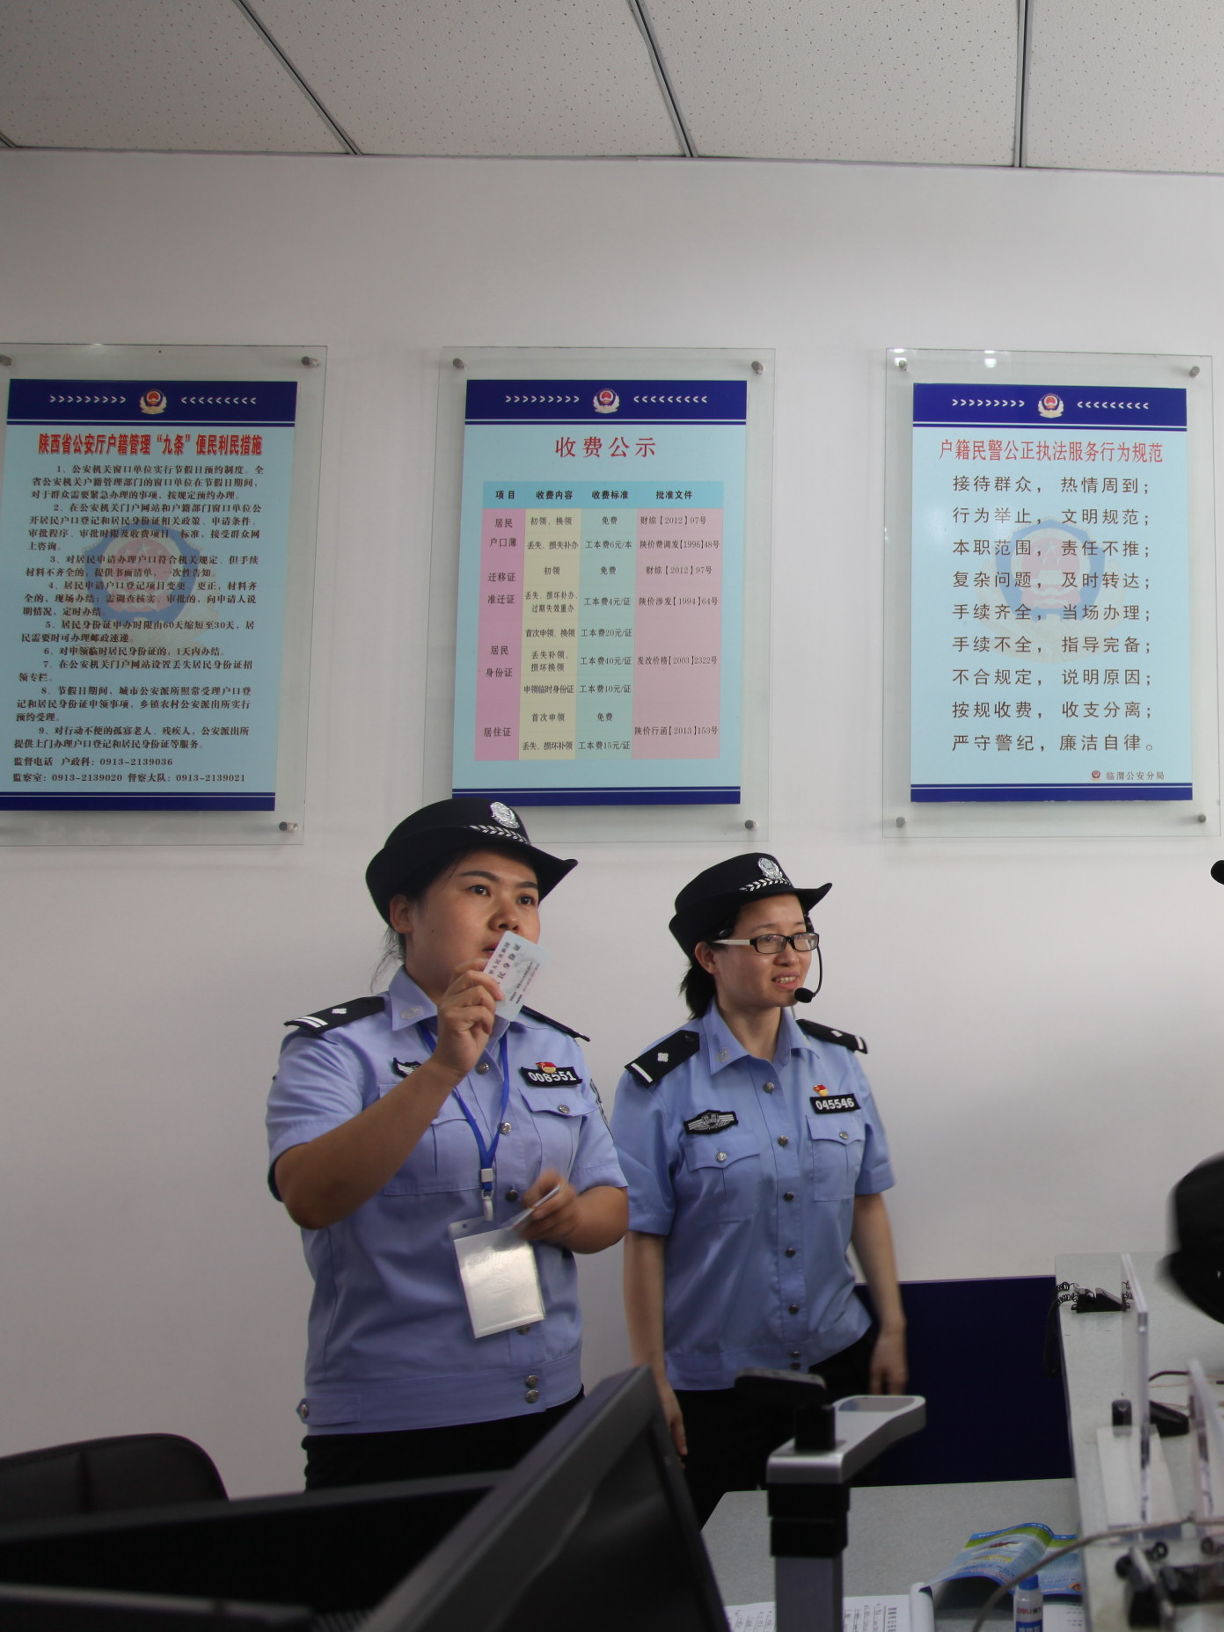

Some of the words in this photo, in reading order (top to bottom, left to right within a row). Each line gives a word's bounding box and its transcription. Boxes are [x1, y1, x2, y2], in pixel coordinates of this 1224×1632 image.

[555, 437, 656, 458] 收费公示
[940, 439, 1163, 463] 户籍民警公正执法服务行为规范
[536, 490, 574, 499] 收费内容
[592, 490, 629, 499] 收费标准
[656, 490, 693, 499] 批准文件
[495, 518, 513, 528] 居民
[602, 516, 618, 525] 免费
[544, 566, 560, 575] 初领
[600, 566, 616, 575] 免费
[488, 573, 516, 583] 迁移证
[487, 595, 515, 605] 准迁证
[491, 645, 509, 655] 居民
[486, 668, 513, 678] 身份证
[532, 713, 565, 722] 首次申领
[597, 713, 612, 721] 免费
[483, 728, 511, 737] 居住证
[14, 757, 53, 766] 监督电话
[1106, 770, 1165, 781] 临渭公安分局
[527, 1070, 577, 1082] 008551
[815, 1096, 854, 1111] 045546
